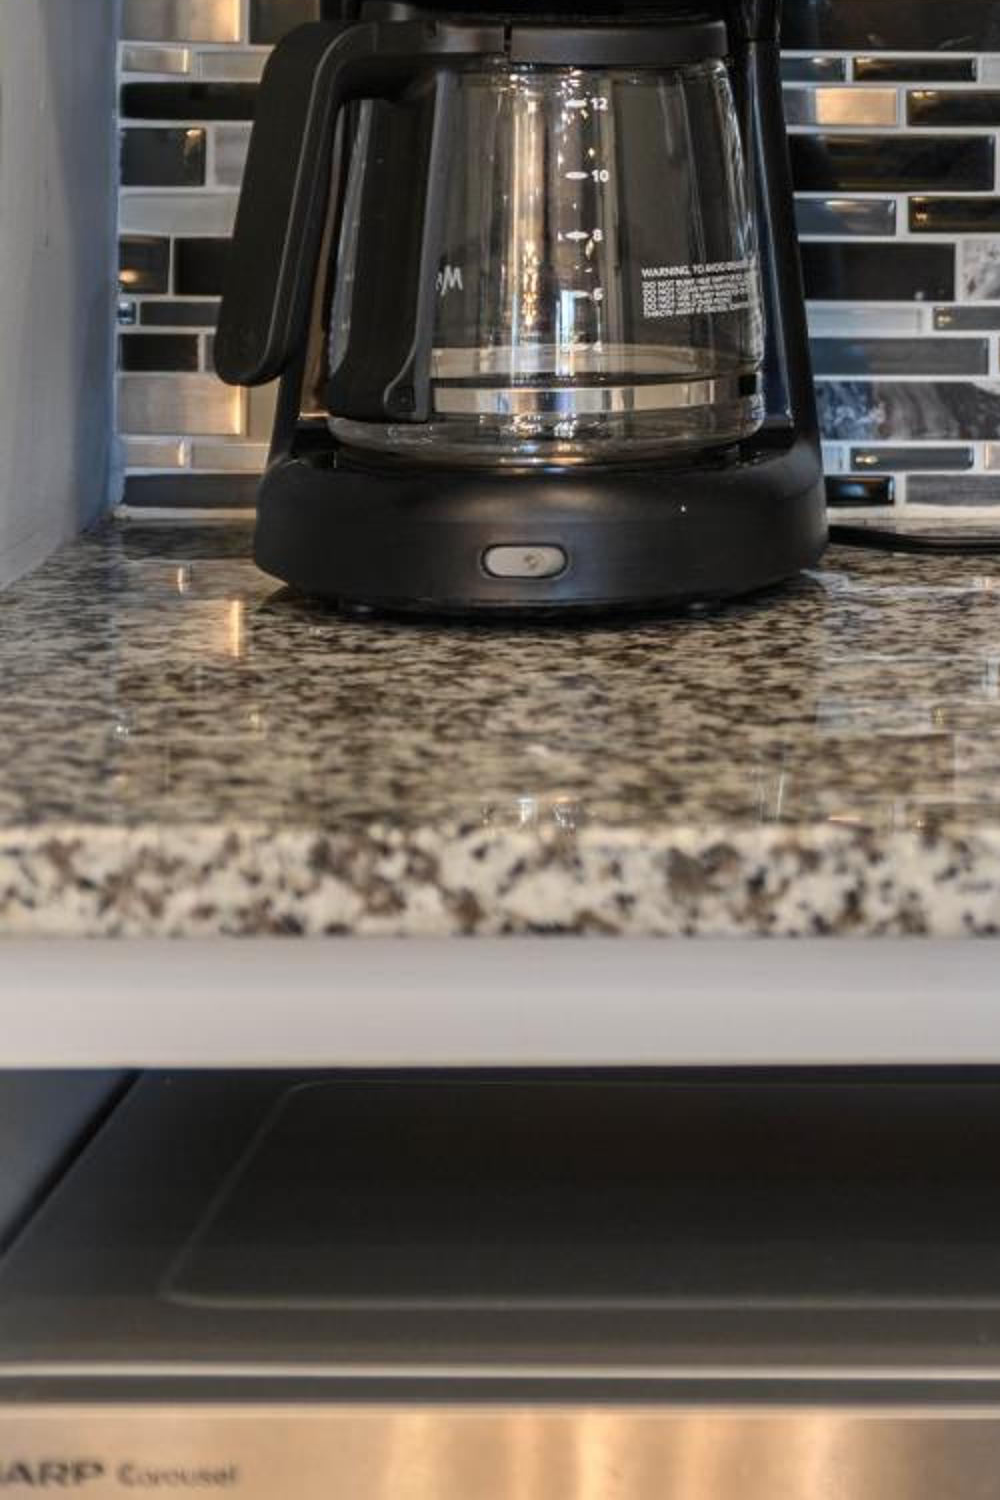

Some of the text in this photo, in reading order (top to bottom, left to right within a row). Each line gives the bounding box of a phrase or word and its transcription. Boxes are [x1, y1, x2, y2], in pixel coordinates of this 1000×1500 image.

[591, 97, 608, 111] 12
[592, 170, 609, 183] 10
[593, 288, 604, 301] 6
[0, 1460, 104, 1486] ARP
